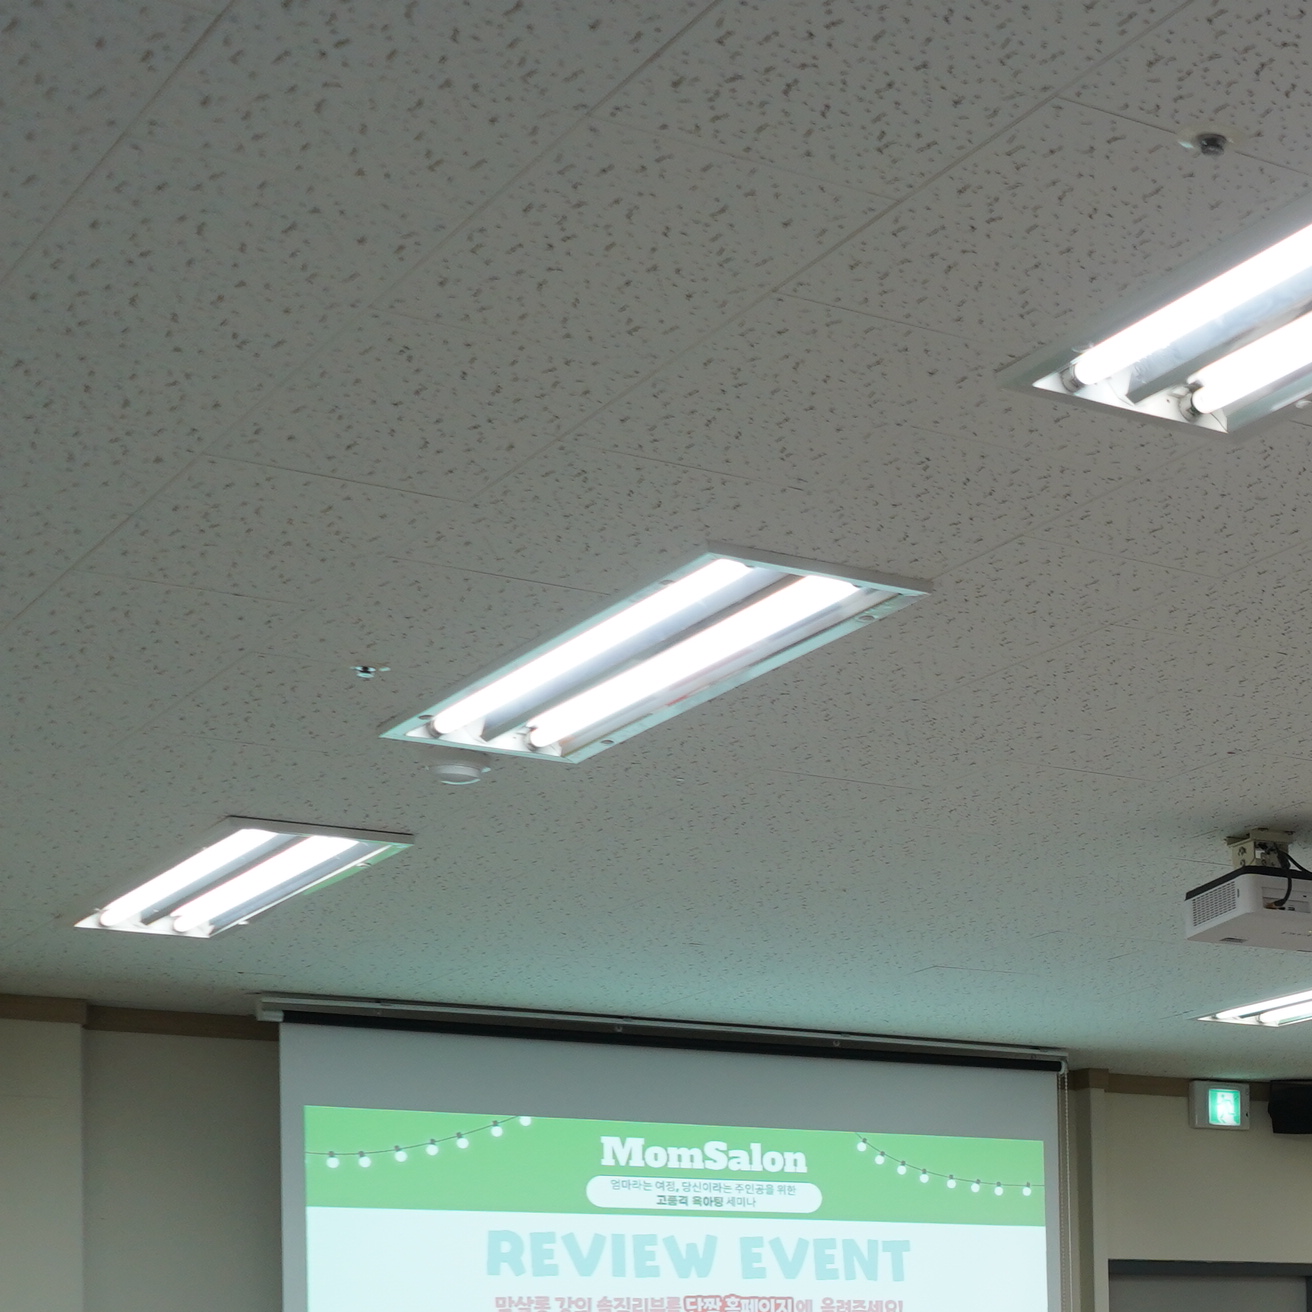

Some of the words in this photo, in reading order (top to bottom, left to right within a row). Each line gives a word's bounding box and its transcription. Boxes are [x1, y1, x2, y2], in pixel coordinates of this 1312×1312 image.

[600, 1136, 808, 1173] MomSalon
[610, 1179, 652, 1191] 엄마라는
[655, 1181, 679, 1192] 여정,
[681, 1181, 732, 1194] 당신이라는
[734, 1183, 774, 1195] 주인공을
[776, 1184, 797, 1196] 위한
[726, 1196, 756, 1208] 세미나
[486, 1229, 718, 1280] REVIEW
[739, 1235, 911, 1282] EVENT
